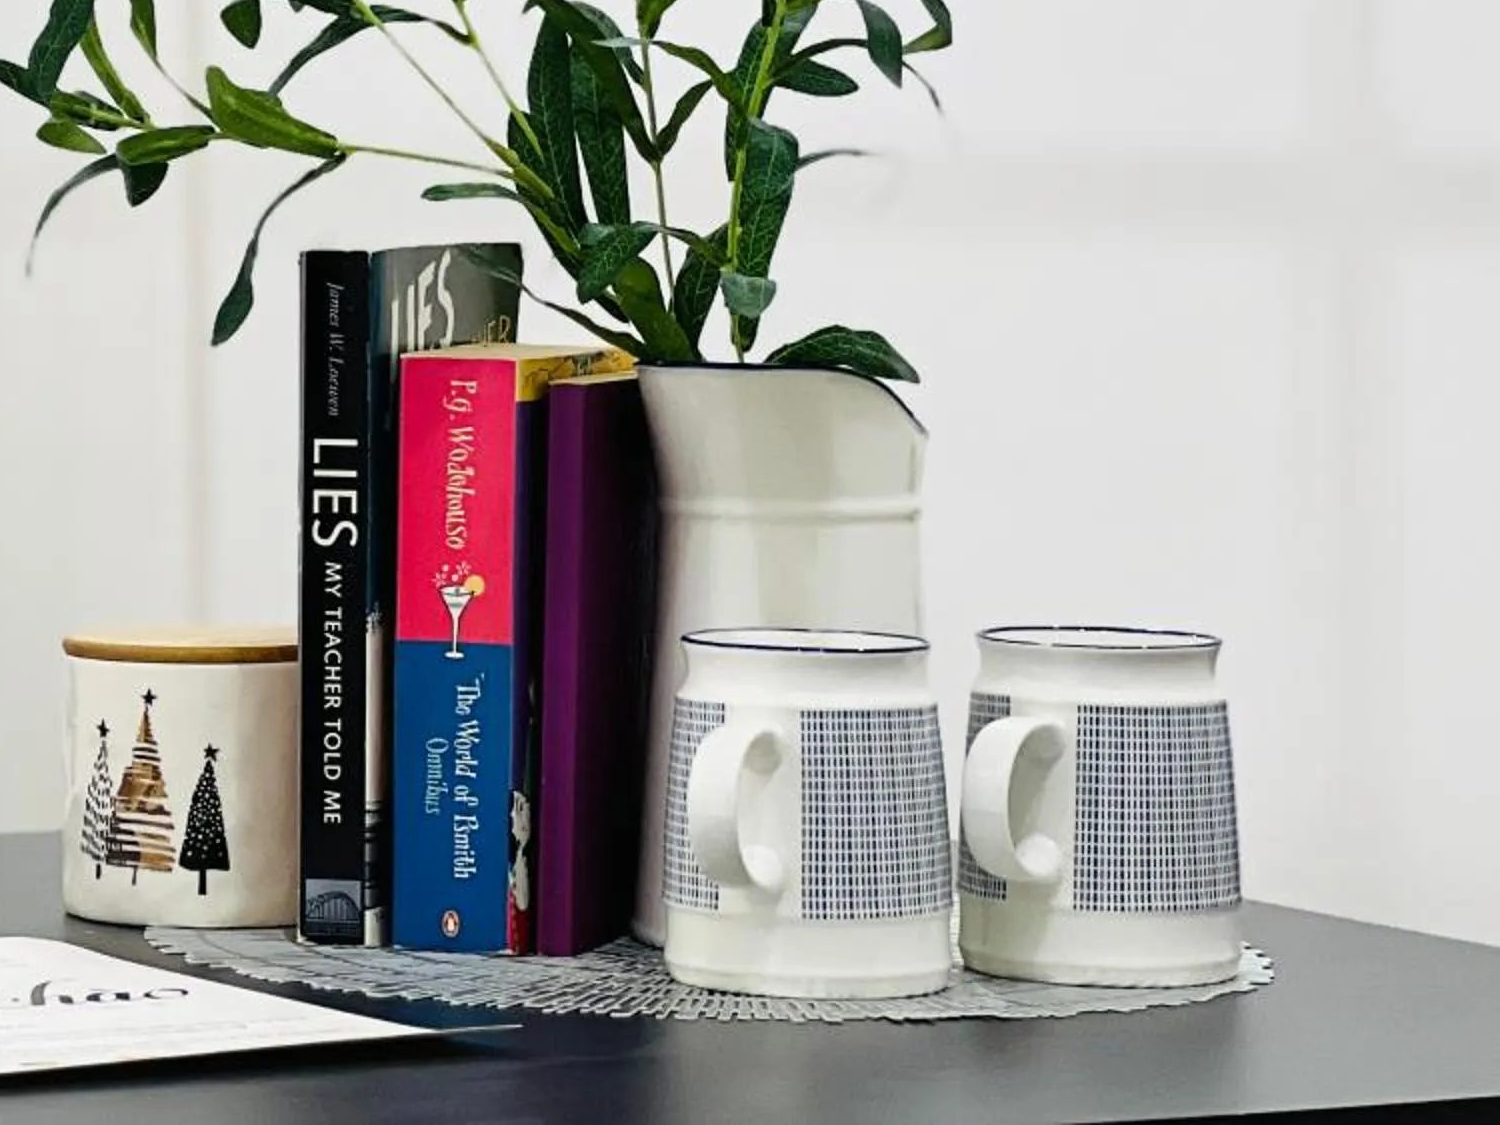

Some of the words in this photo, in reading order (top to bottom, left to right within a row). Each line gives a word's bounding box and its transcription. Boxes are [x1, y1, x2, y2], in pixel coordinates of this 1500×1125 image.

[326, 281, 345, 327] James
[327, 357, 345, 416] Loewen
[312, 438, 359, 547] LIES
[445, 426, 476, 550] Wodehouse
[324, 561, 342, 598] MY
[324, 607, 342, 709] TEACHER
[455, 672, 485, 716] The
[324, 719, 342, 781] TOLD
[425, 736, 449, 815] Omnibus
[453, 719, 481, 779] World
[323, 790, 341, 824] ME
[453, 784, 479, 807] of
[453, 813, 480, 879] Psmith
